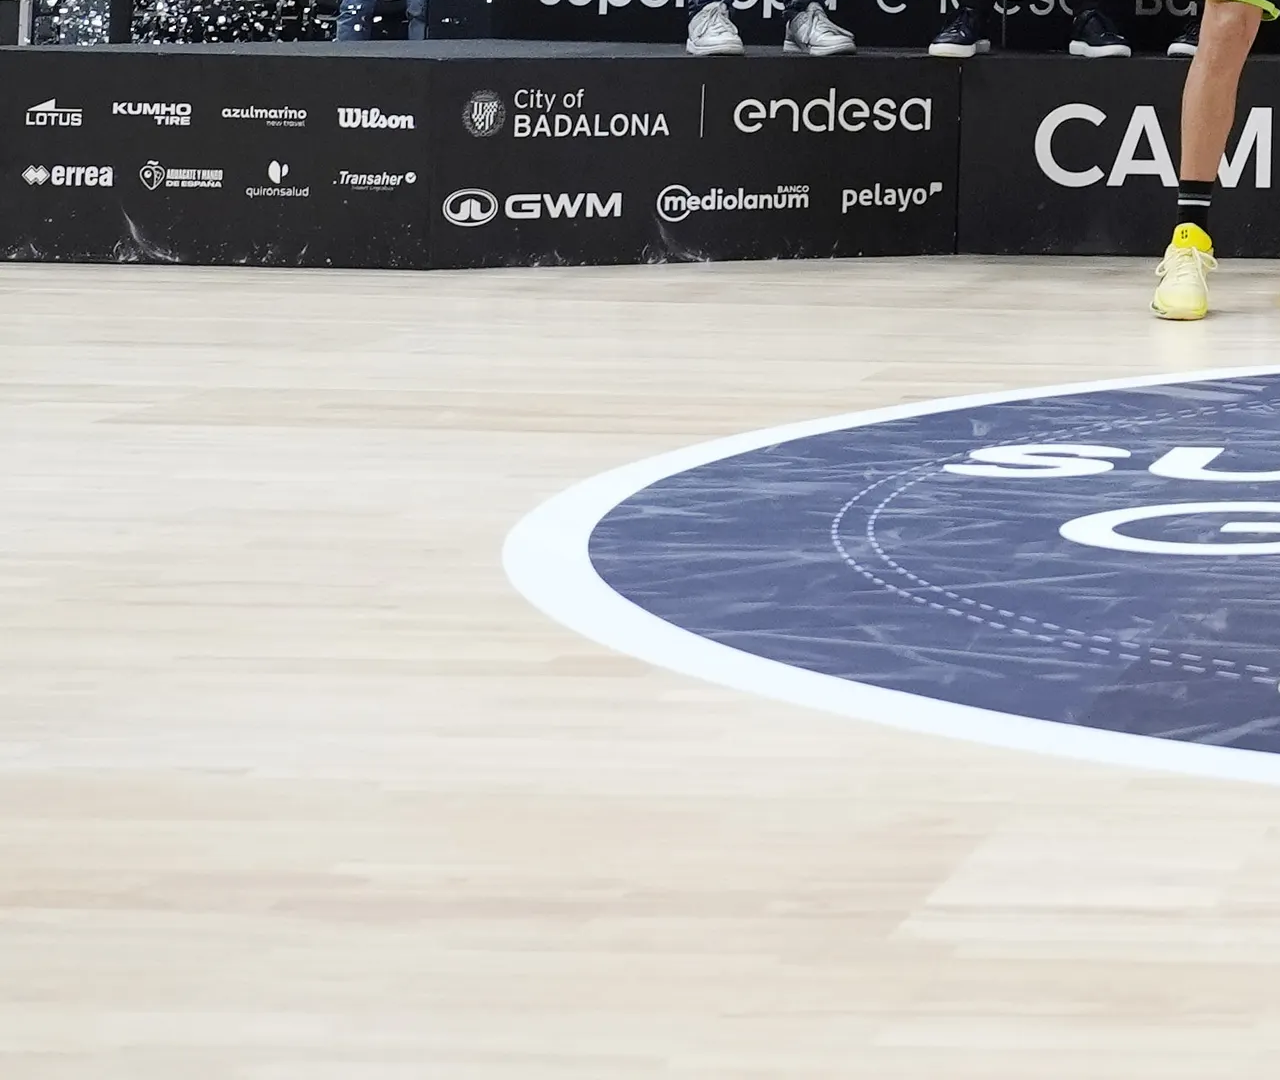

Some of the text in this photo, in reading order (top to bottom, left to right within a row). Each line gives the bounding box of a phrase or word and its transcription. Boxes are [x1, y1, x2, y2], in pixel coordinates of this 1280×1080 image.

[112, 102, 192, 116] KUMHO
[514, 88, 585, 112] City of
[733, 87, 933, 134] endesa
[25, 112, 83, 127] LOTUS
[154, 116, 191, 126] TIRE
[221, 105, 307, 120] azulmarino
[337, 107, 415, 130] Wilson
[514, 113, 671, 138] BADALONA
[180, 180, 223, 188] ESPAÑA
[776, 184, 810, 194] BANCO
[504, 192, 623, 220] GWM
[663, 187, 810, 214] mediolanum
[841, 182, 927, 213] pelayo
